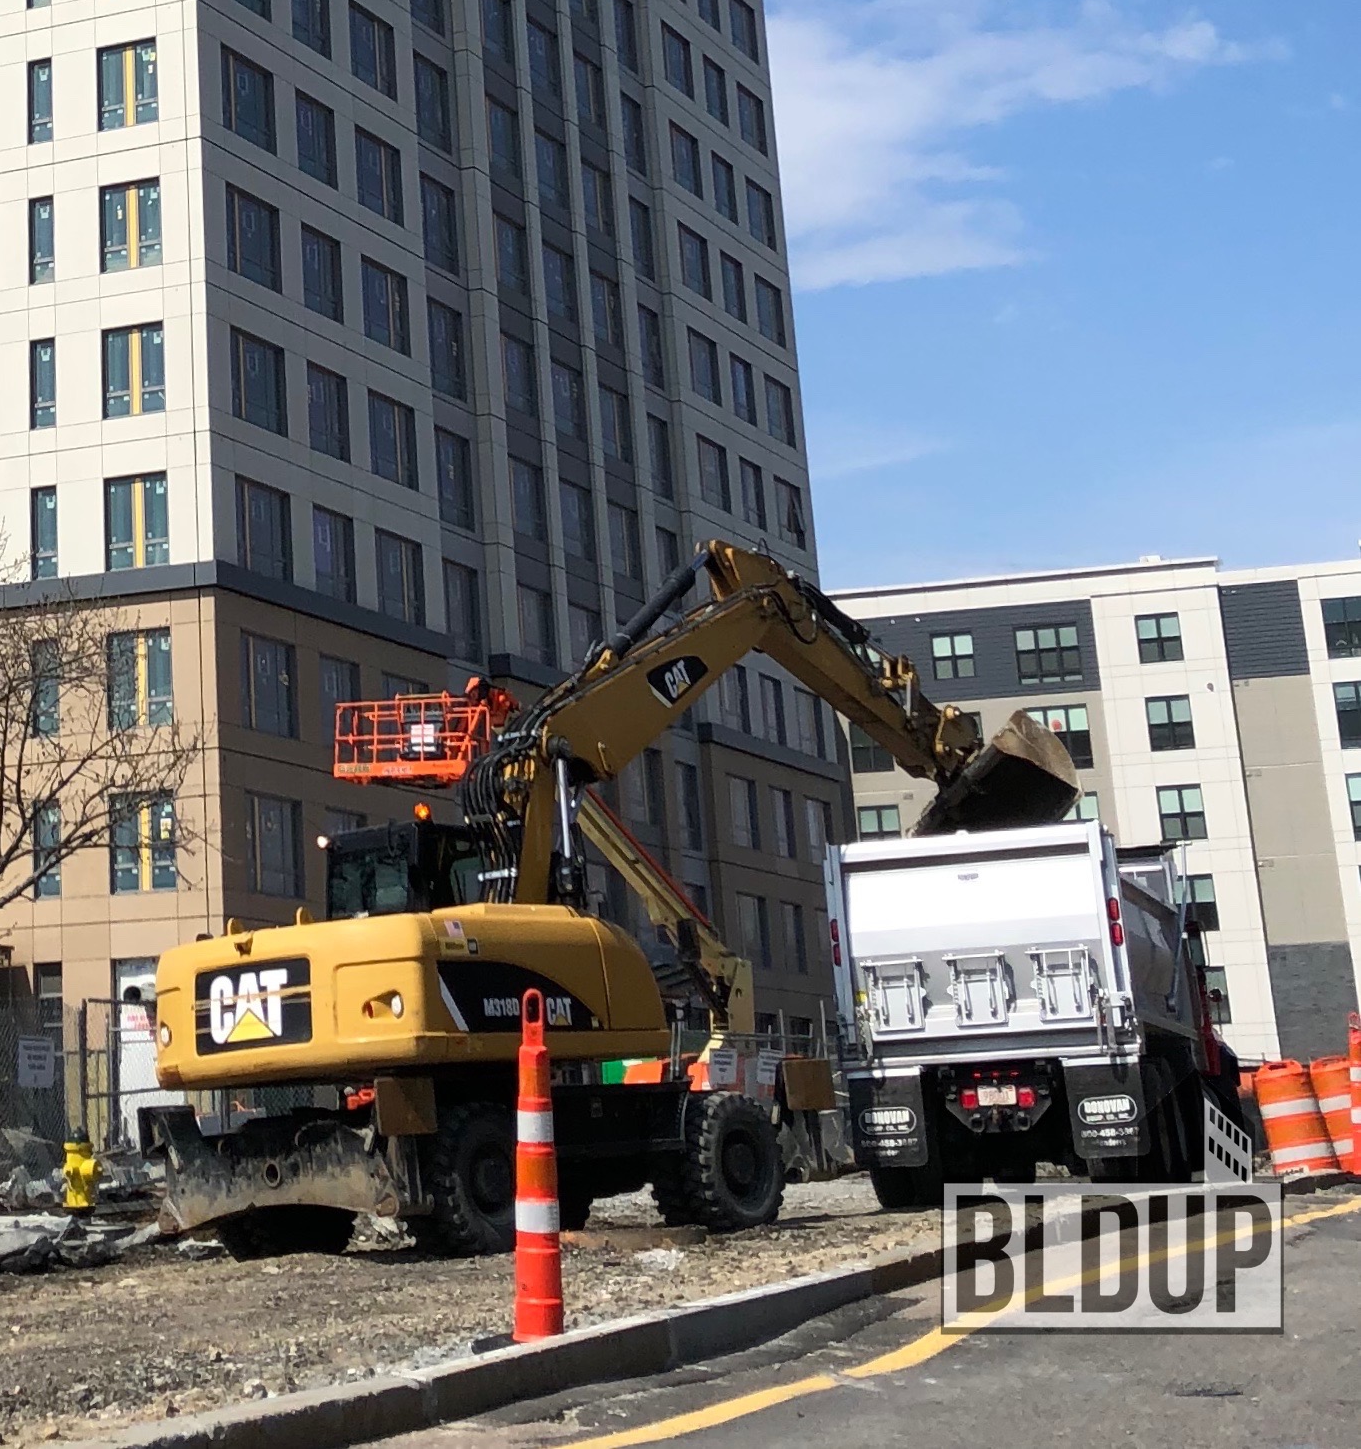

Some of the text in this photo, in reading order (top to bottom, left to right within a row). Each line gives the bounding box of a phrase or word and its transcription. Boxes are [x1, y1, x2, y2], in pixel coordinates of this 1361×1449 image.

[664, 659, 691, 698] CAT
[210, 968, 287, 1044] CAT
[546, 997, 572, 1026] CAT
[865, 1110, 910, 1124] DONOVAN
[1084, 1098, 1130, 1113] DONOVAN
